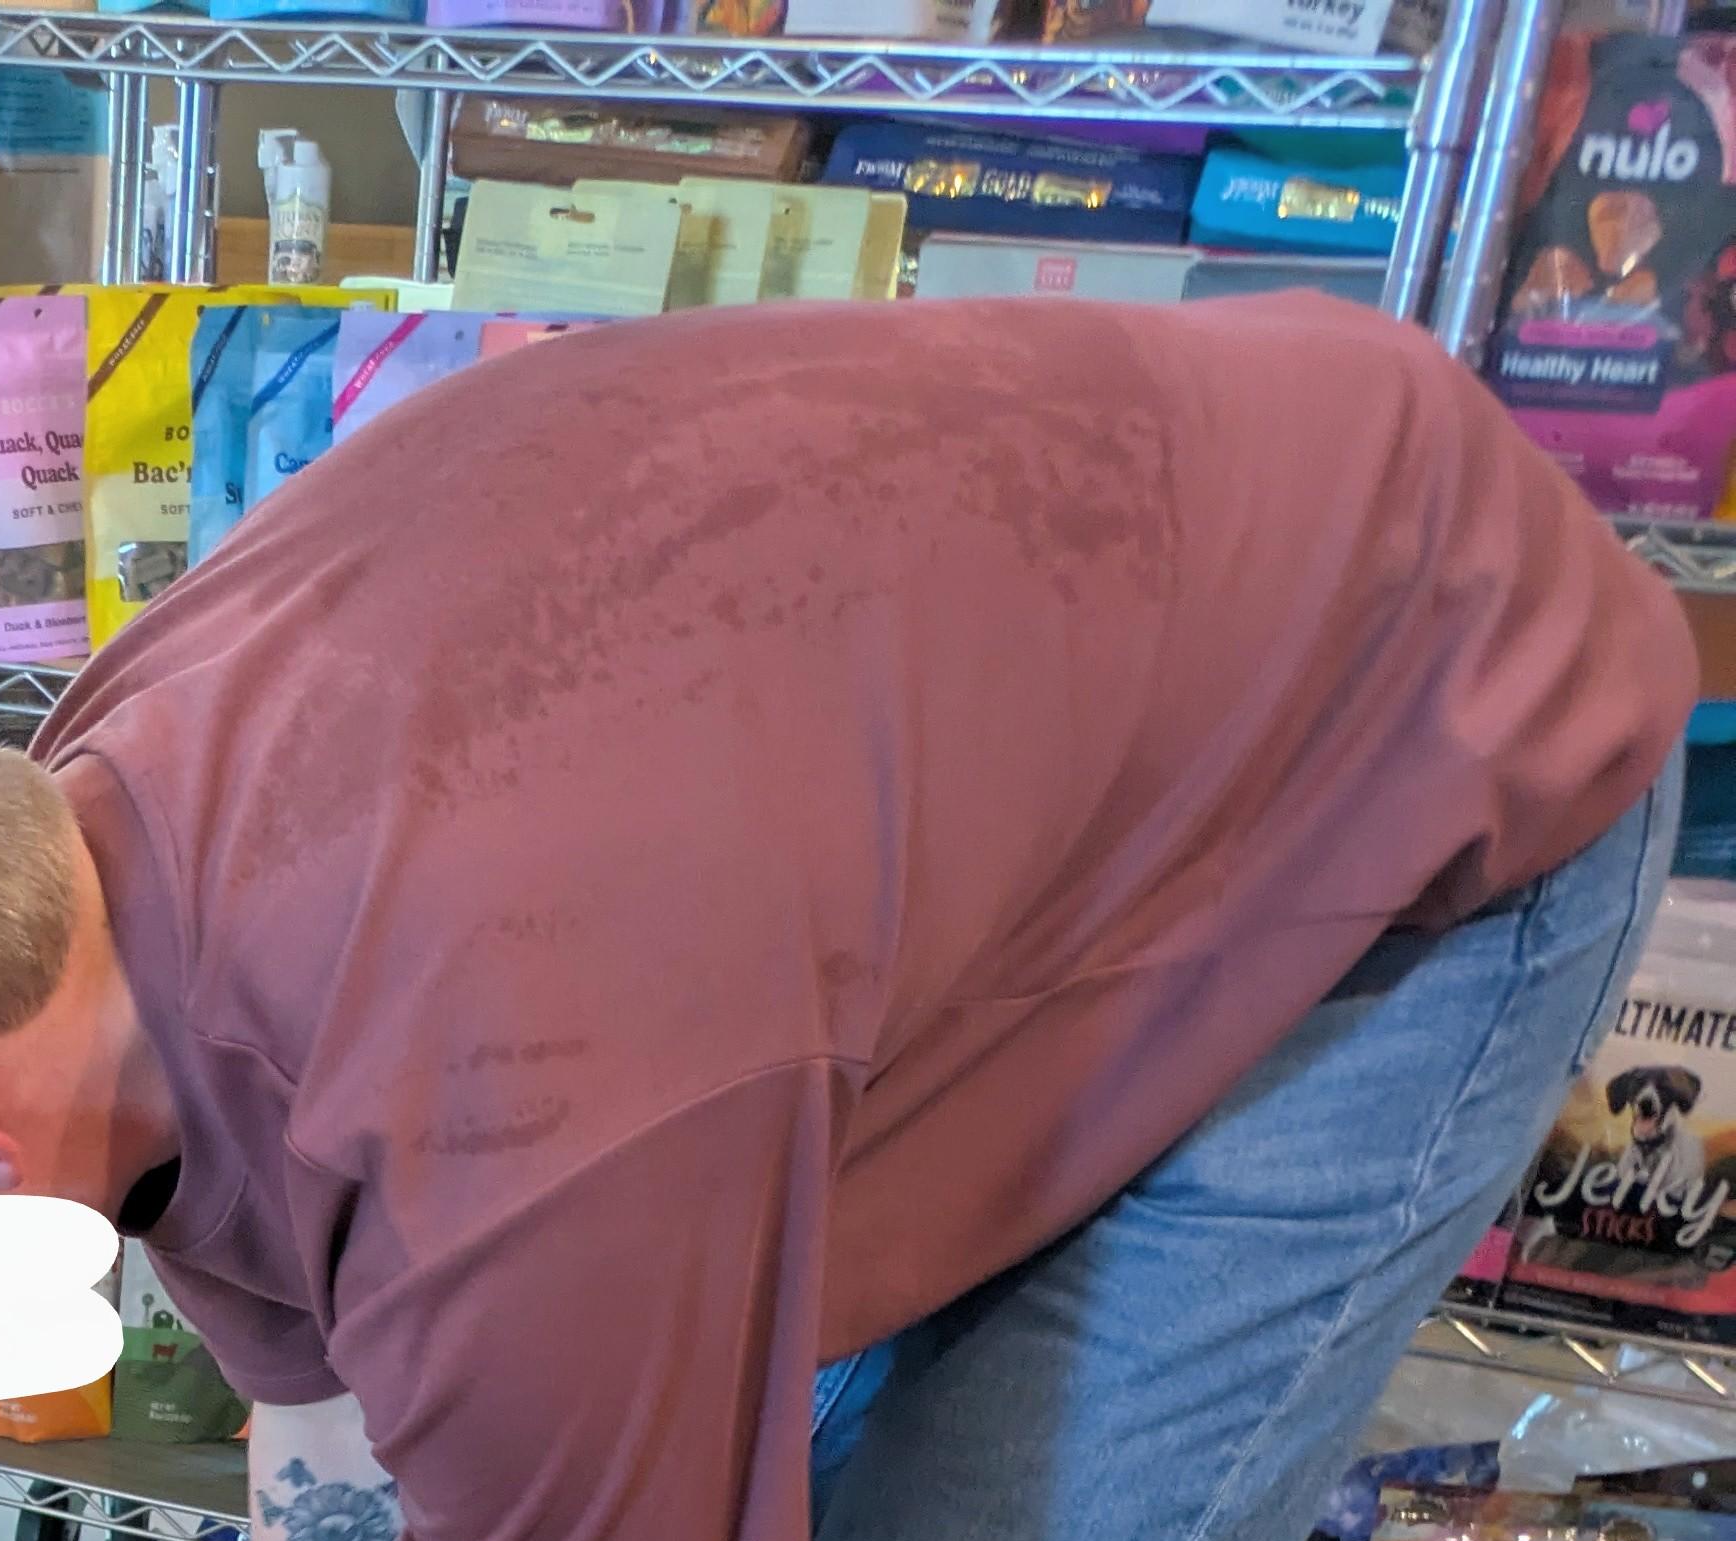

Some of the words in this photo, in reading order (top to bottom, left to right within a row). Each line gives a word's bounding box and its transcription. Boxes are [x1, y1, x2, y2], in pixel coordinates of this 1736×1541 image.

[1577, 122, 1699, 182] nulo
[1500, 352, 1587, 385] Healthy
[1590, 355, 1659, 385] Heart
[45, 429, 85, 456] Qua
[20, 461, 80, 491] Quack
[12, 505, 44, 520] SOFT
[1614, 998, 1736, 1051] LTIMATE
[1532, 1140, 1731, 1247] Jerky
